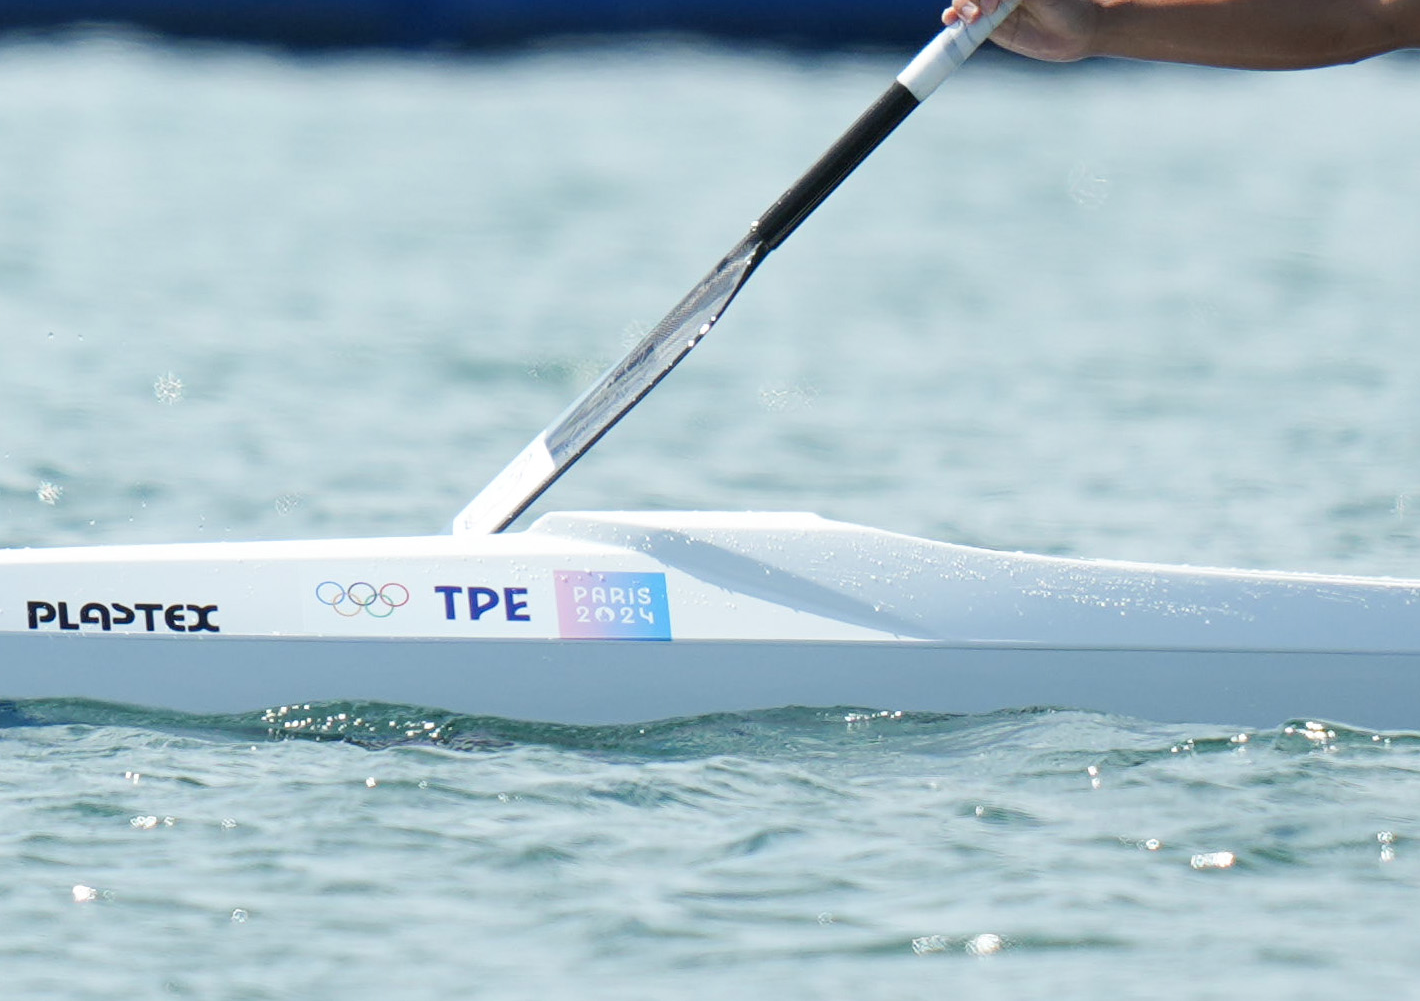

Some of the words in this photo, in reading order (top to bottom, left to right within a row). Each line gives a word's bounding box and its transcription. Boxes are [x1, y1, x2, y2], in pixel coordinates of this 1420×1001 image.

[27, 601, 220, 632] PLASTEX
[434, 586, 531, 621] TPE
[576, 606, 655, 624] 2024
